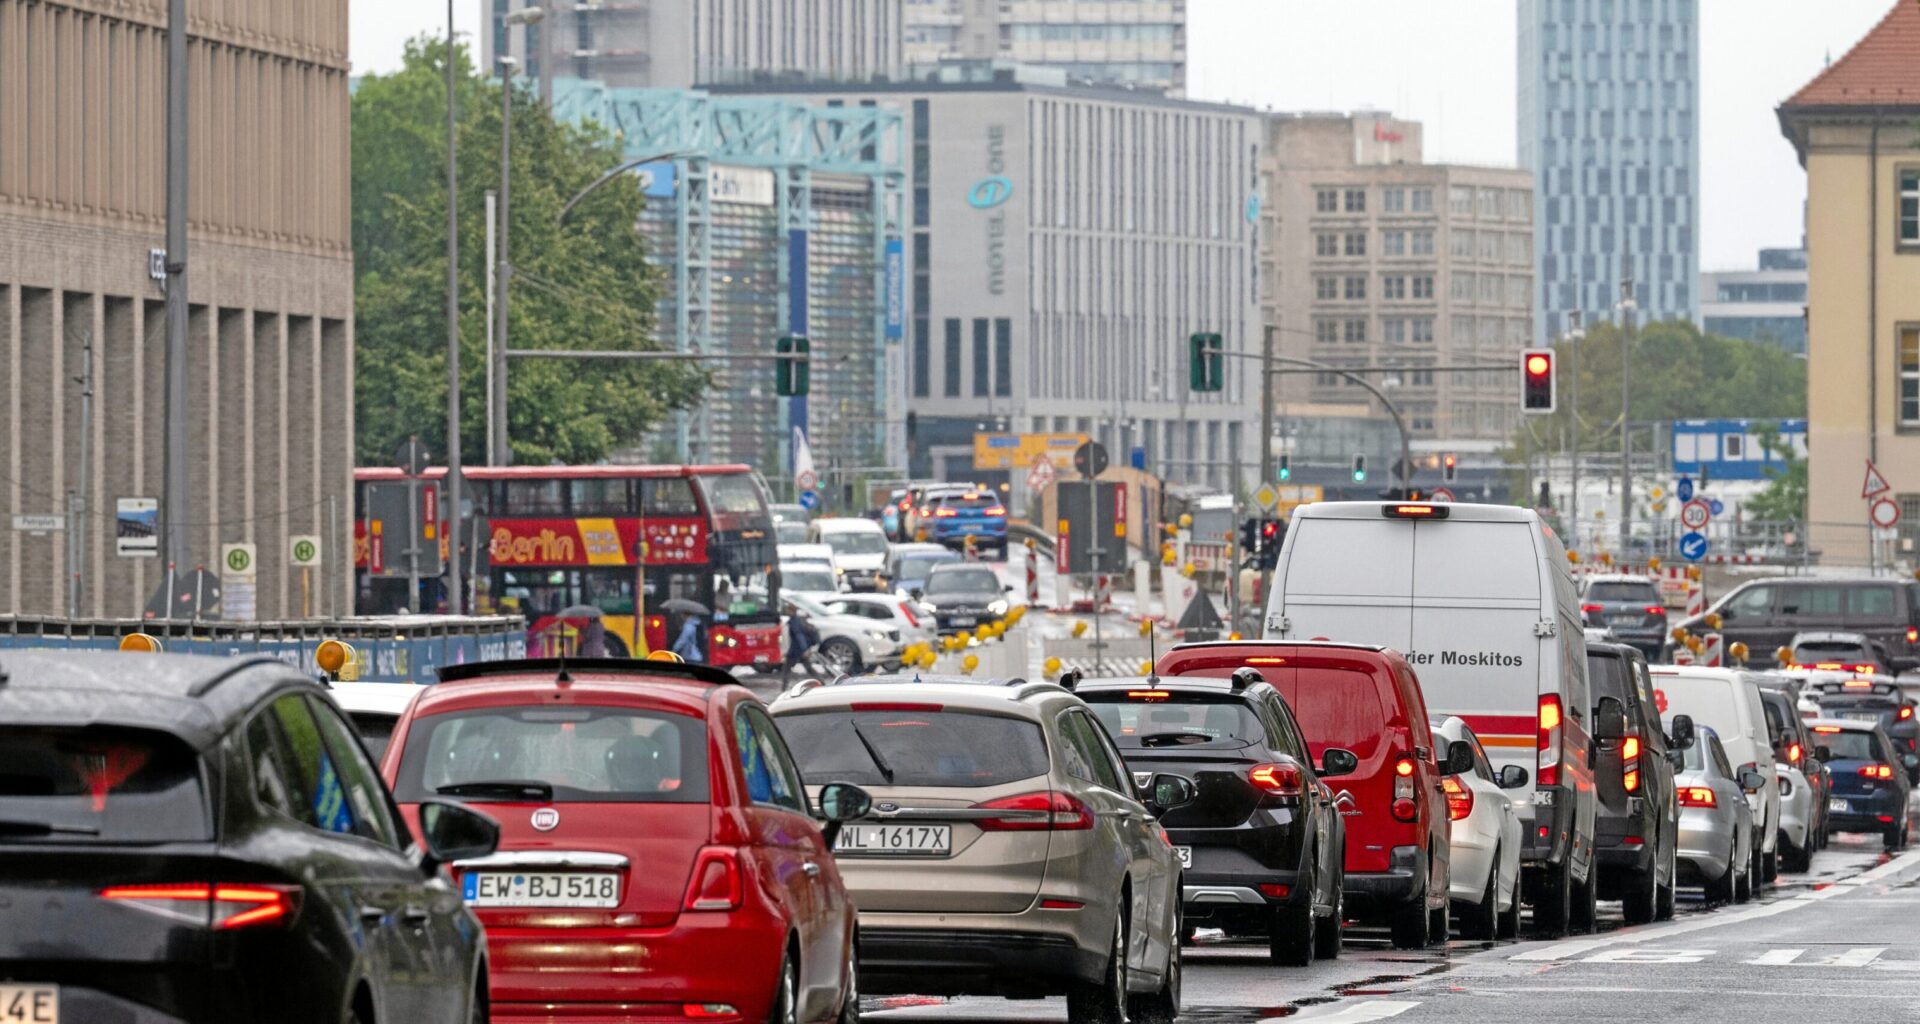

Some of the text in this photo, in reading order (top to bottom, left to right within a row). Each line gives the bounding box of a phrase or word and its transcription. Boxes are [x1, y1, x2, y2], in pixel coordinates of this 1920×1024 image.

[1687, 508, 1704, 522] 30
[493, 527, 575, 562] Berlin
[1405, 650, 1523, 667] rier Moskitos
[841, 827, 945, 848] WL 1617X
[479, 876, 512, 898] EW
